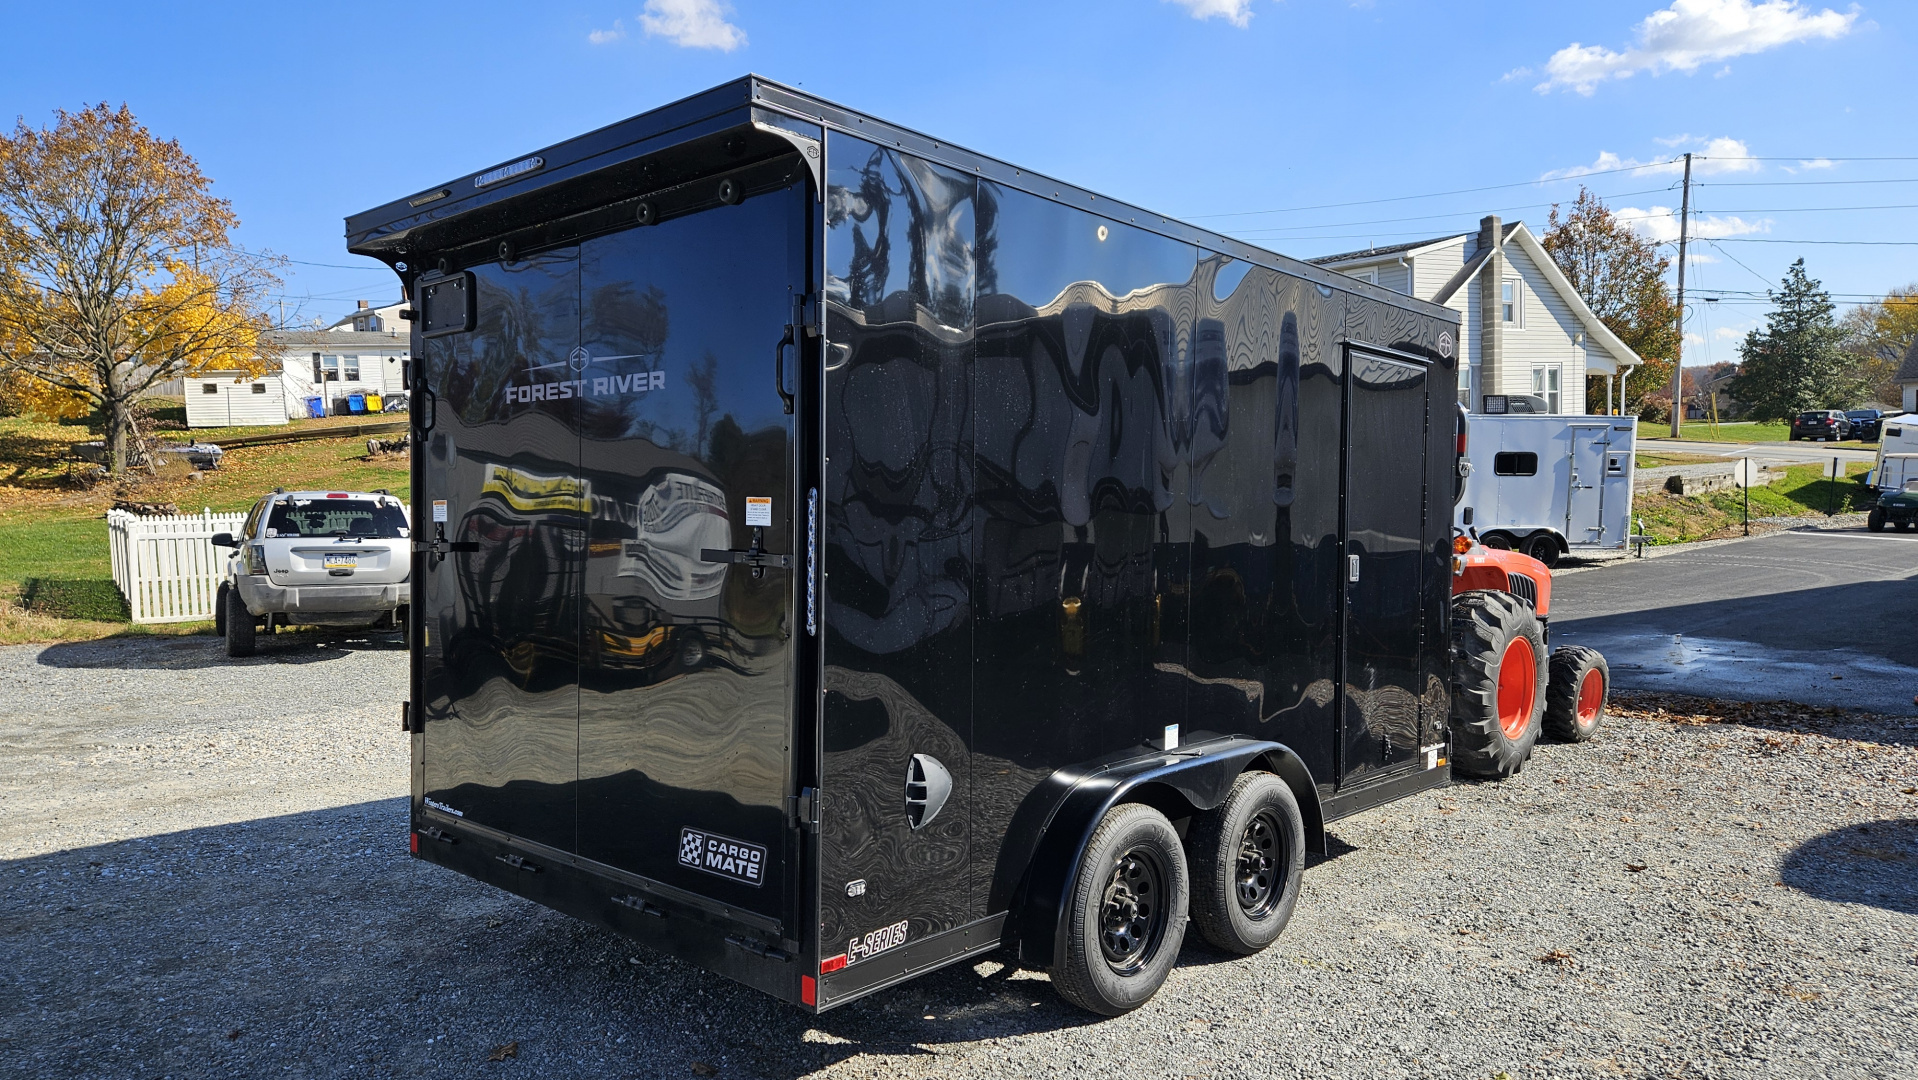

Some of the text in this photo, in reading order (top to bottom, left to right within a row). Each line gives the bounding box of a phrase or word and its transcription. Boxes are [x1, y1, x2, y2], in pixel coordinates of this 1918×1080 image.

[505, 370, 666, 404] FOREST RIVER
[705, 852, 759, 879] MATE
[707, 839, 761, 863] CARGO
[846, 920, 908, 964] E-SERIES
